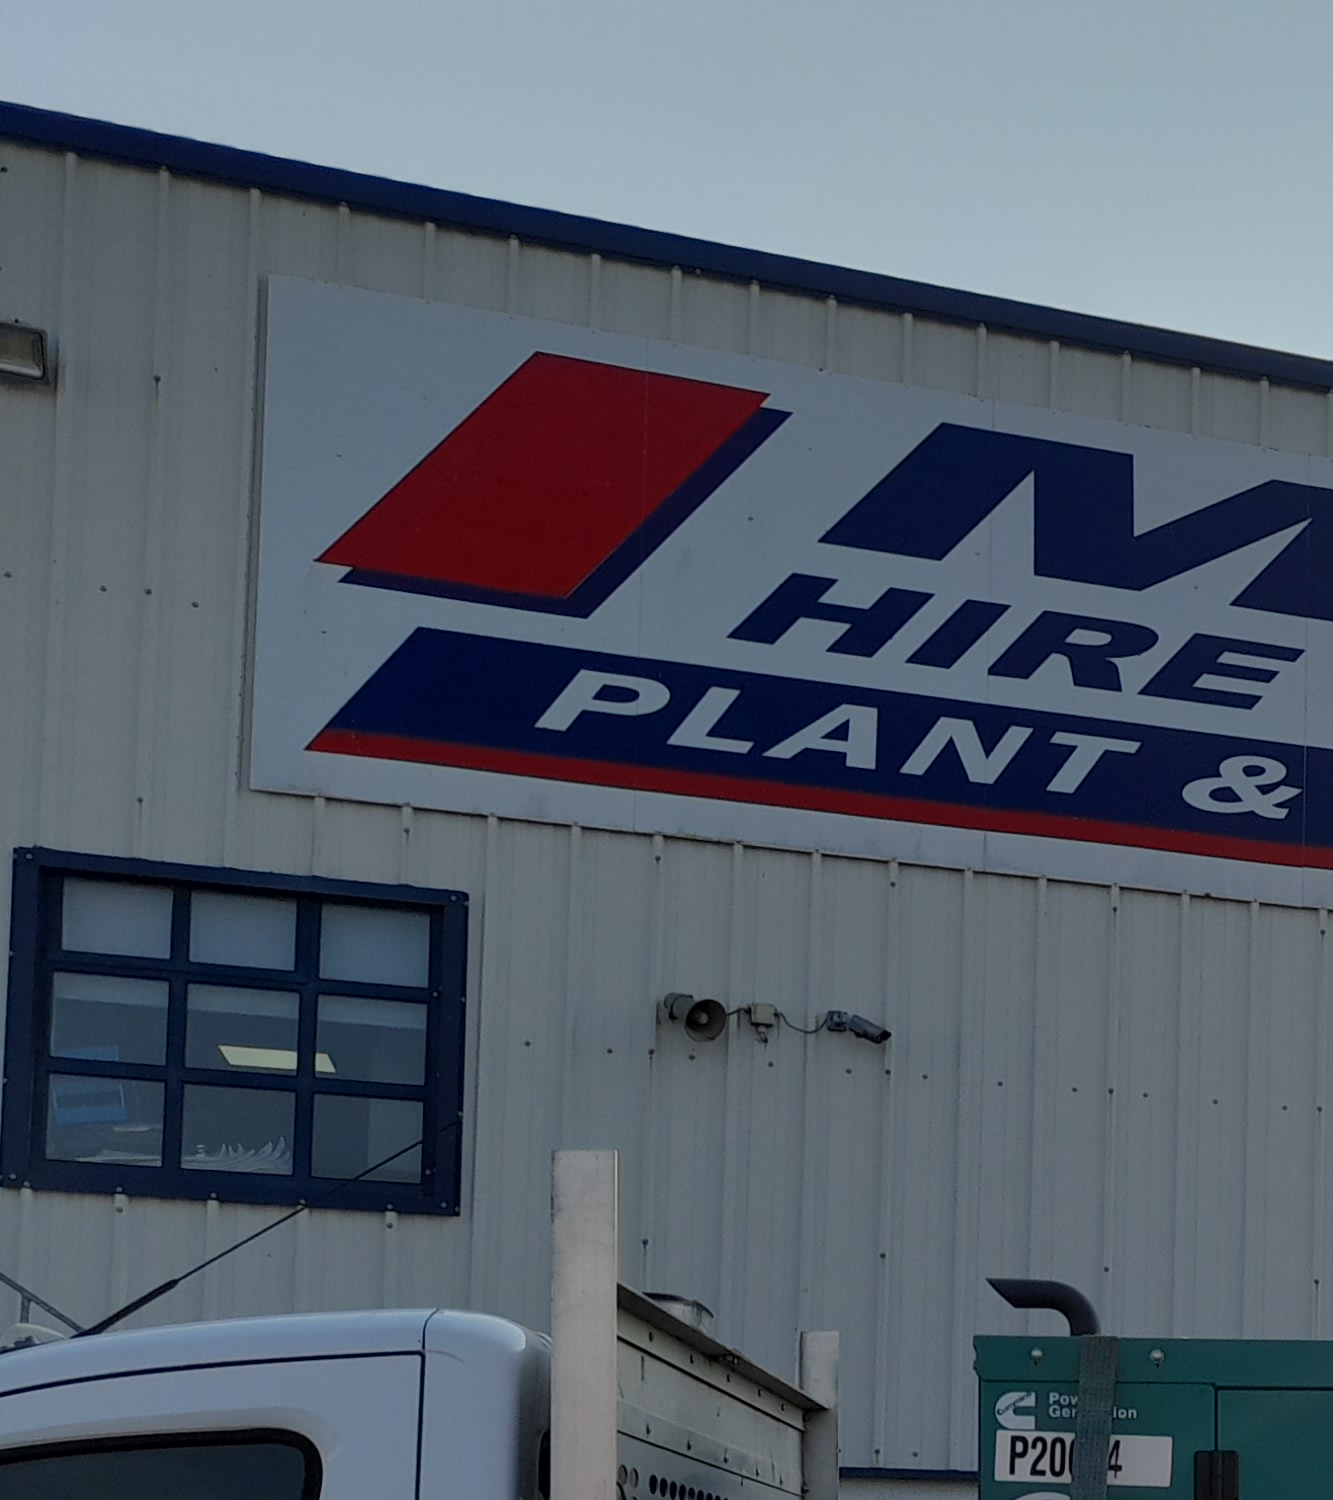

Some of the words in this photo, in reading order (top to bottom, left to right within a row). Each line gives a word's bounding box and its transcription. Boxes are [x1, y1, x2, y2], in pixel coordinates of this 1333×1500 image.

[728, 572, 1305, 710] HIRE
[535, 668, 1141, 795] PLANT
[1181, 753, 1302, 821] &
[1009, 1435, 1123, 1479] P204
